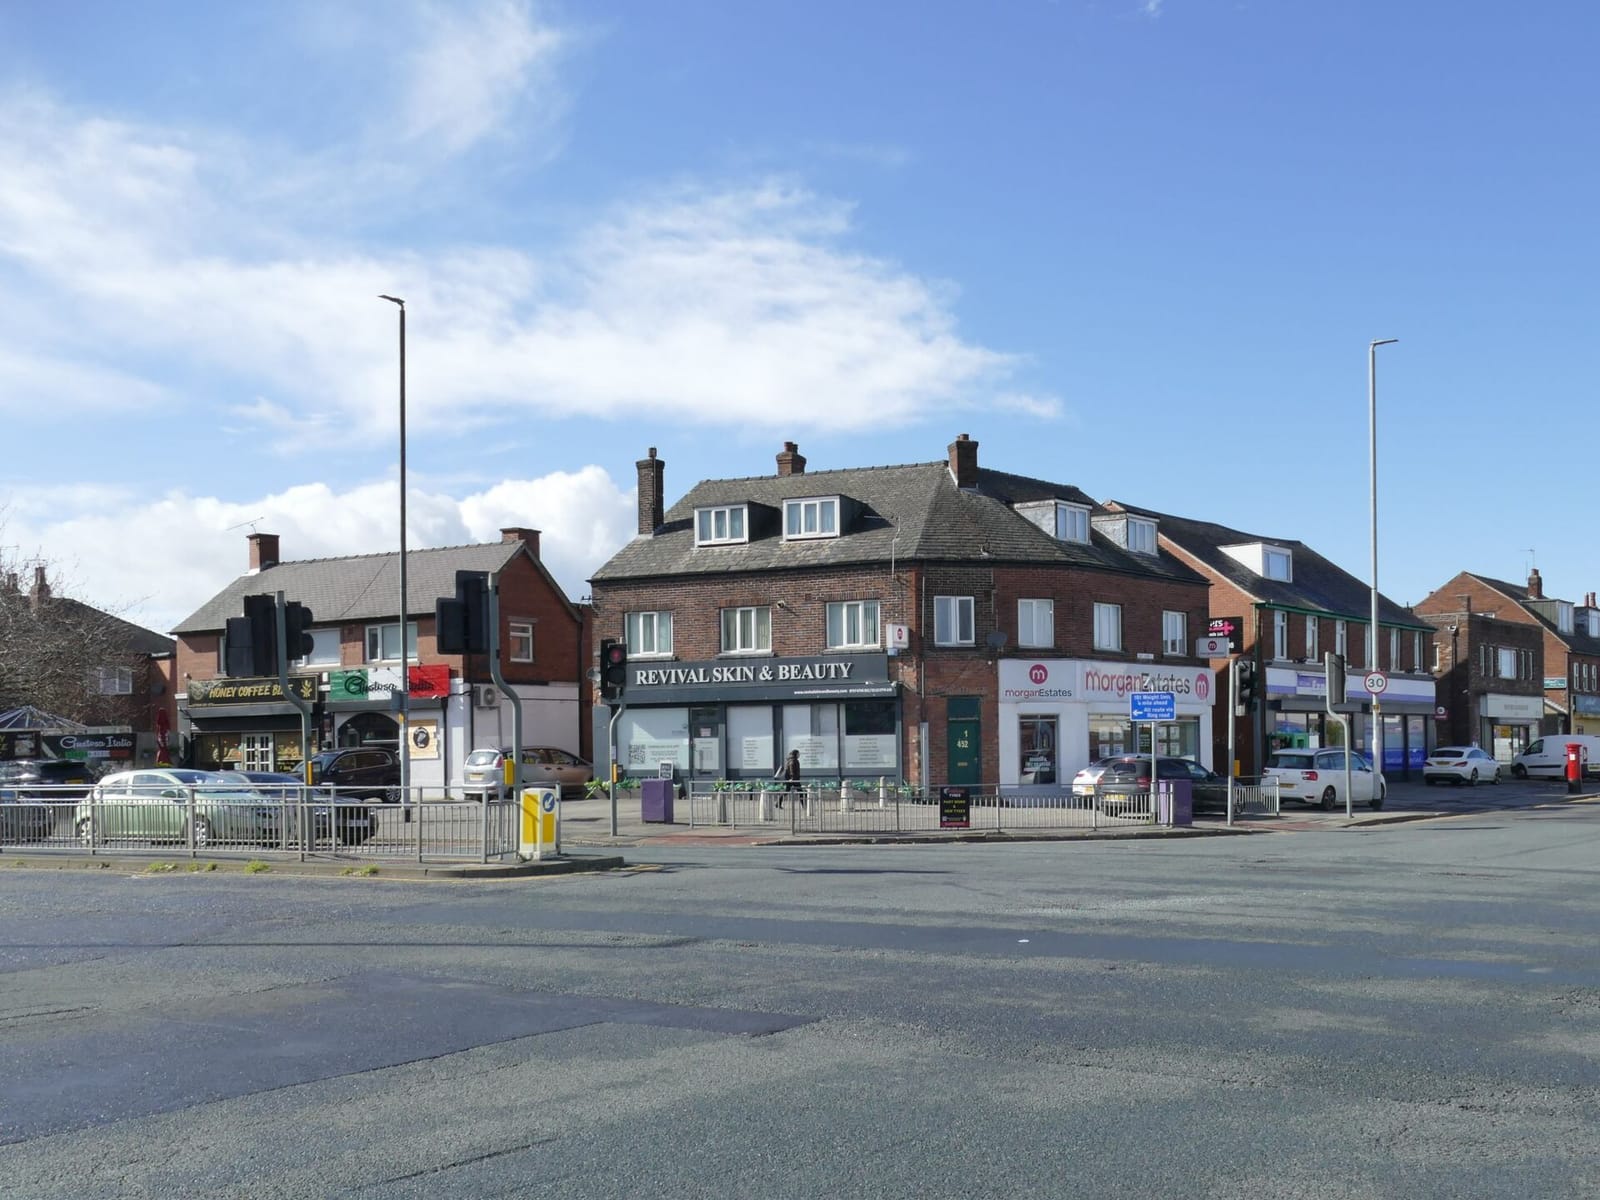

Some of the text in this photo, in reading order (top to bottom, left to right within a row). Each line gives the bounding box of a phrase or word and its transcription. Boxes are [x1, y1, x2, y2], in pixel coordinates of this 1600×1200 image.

[635, 662, 852, 685] REVIVAL SKIN & BEAUTY
[1367, 678, 1384, 688] 30
[208, 686, 237, 699] HONEY
[238, 684, 271, 698] COFFEE
[1005, 688, 1073, 700] morganEstates
